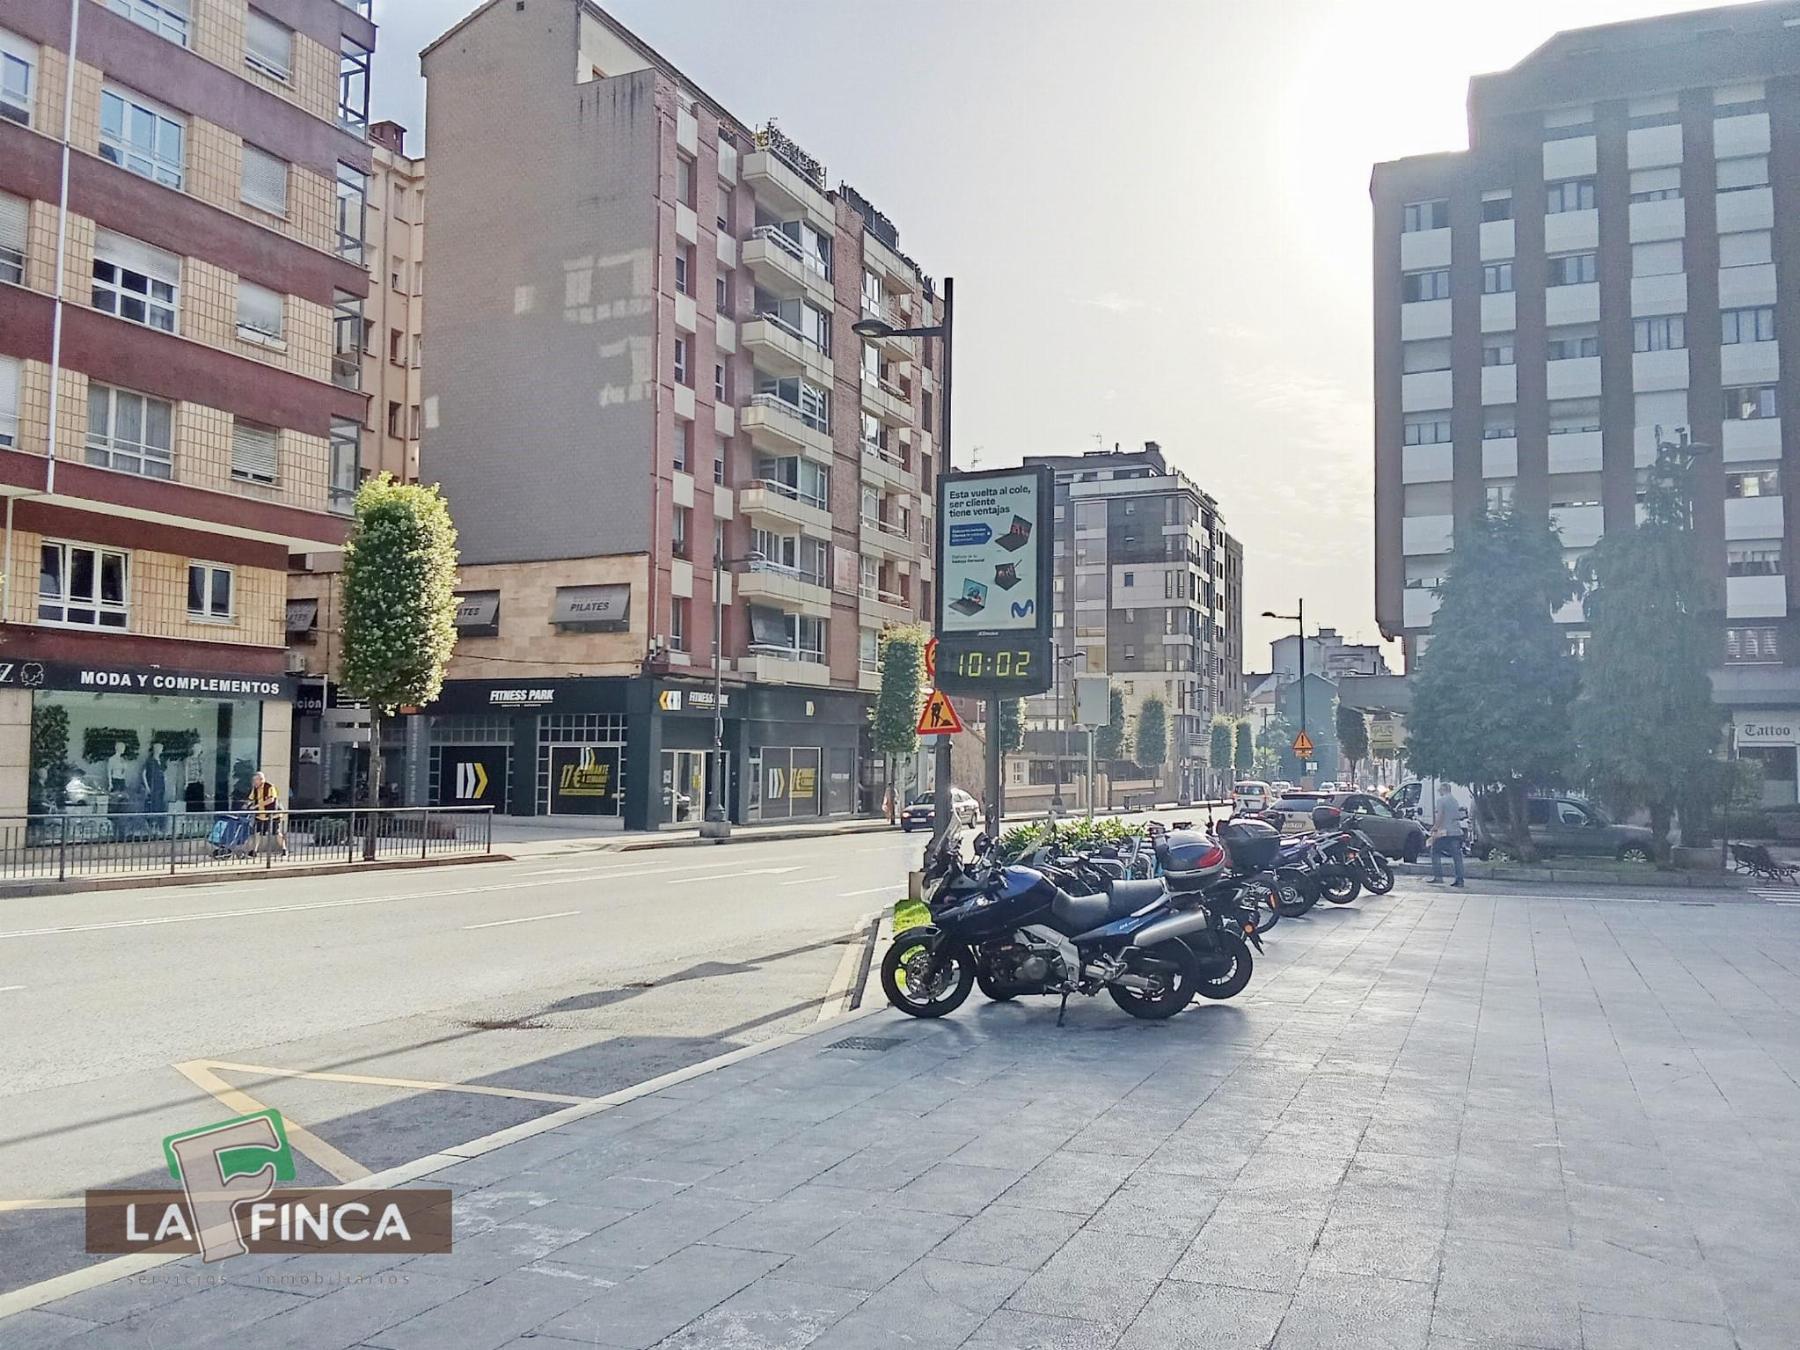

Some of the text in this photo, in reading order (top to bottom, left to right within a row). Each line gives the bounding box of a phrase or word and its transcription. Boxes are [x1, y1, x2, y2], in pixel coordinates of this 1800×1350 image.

[949, 485, 1031, 499] Esta vuelta al cole,
[966, 498, 996, 507] cliente
[949, 505, 1010, 518] tiene ventajas
[457, 607, 480, 616] ATES
[569, 602, 610, 612] PILATES
[959, 651, 1031, 677] 10:02
[80, 671, 280, 695] MODA Y COMPLEMENTOS
[489, 689, 555, 701] FITNESS PARK
[688, 691, 713, 704] FITNESS
[1743, 723, 1791, 737] Tattoo
